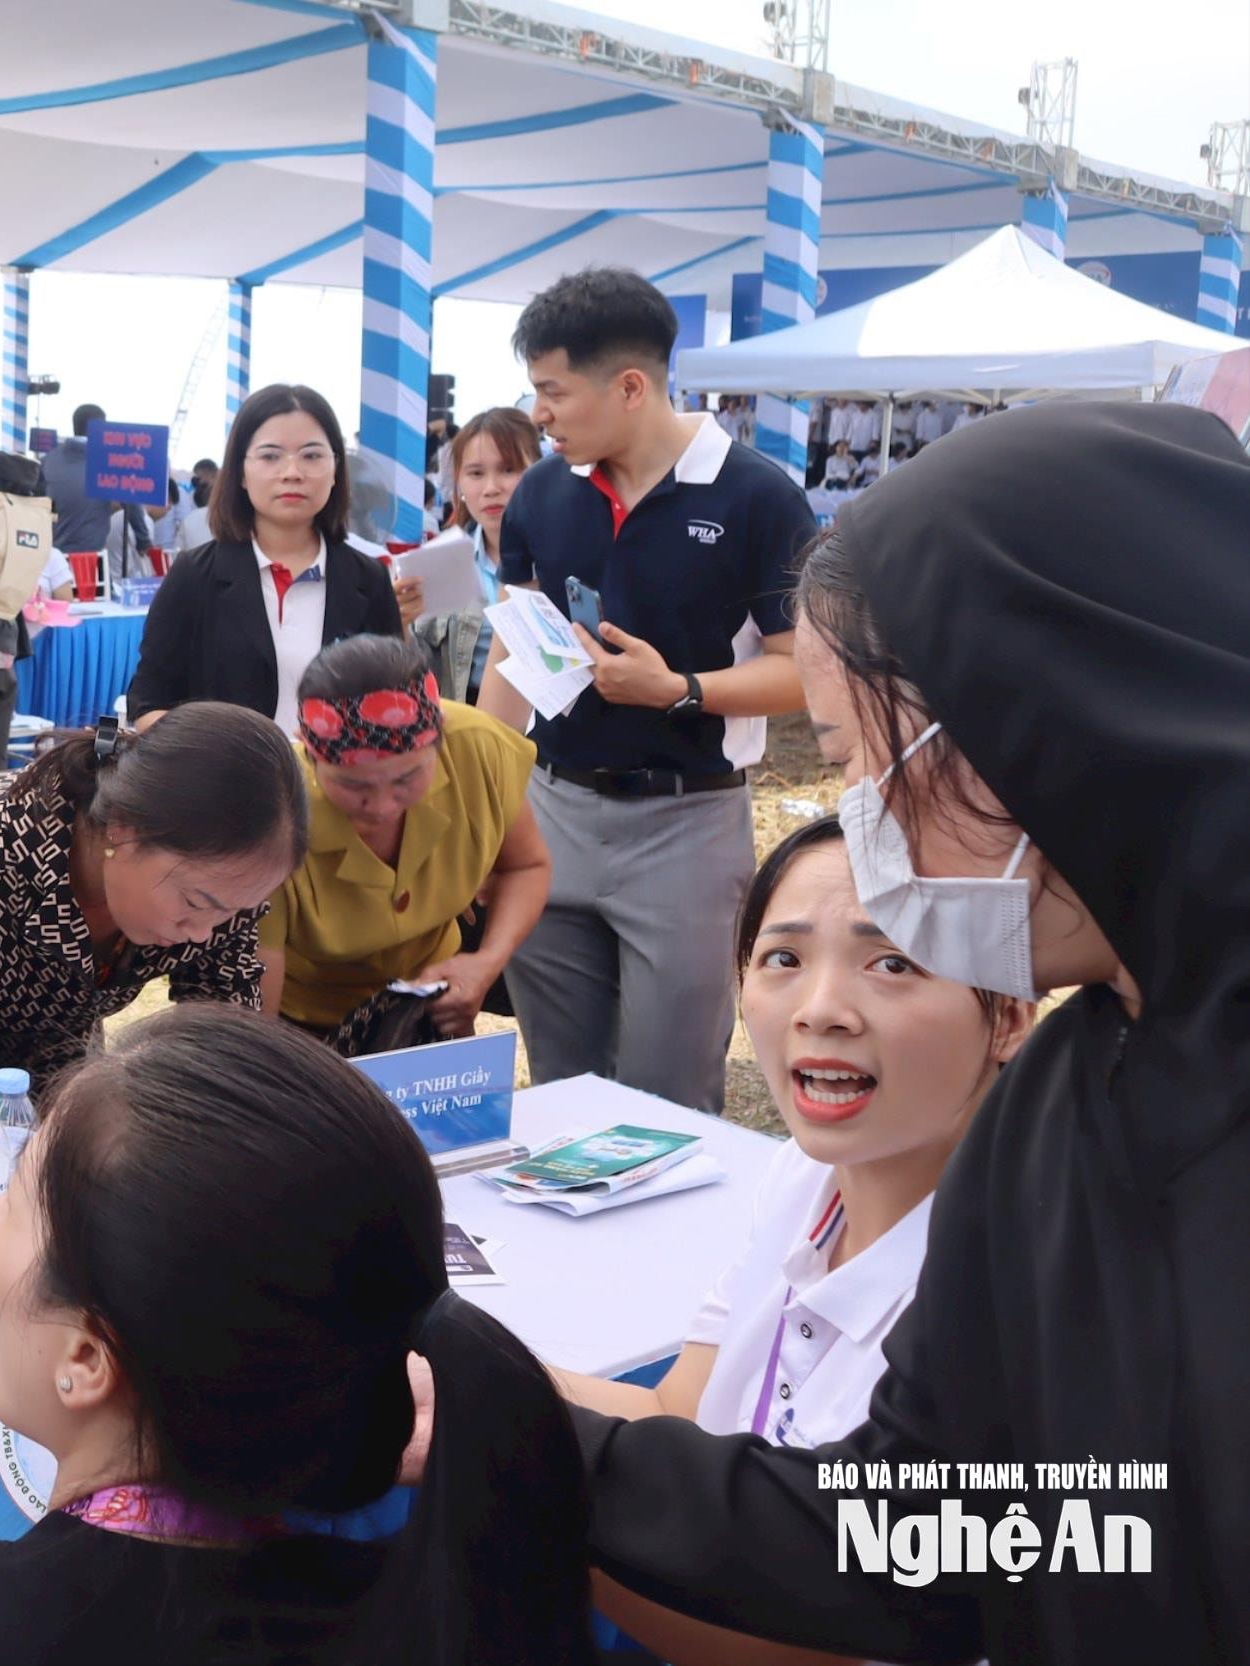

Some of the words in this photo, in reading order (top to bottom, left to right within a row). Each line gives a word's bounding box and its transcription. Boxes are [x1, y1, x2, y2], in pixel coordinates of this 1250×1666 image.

[396, 1085, 410, 1100] ty
[413, 1074, 457, 1096] TNHH
[421, 1099, 448, 1116] Việt
[451, 1094, 482, 1111] Nam
[8, 1461, 30, 1495] ĐỘNG
[28, 1494, 47, 1513] LAO
